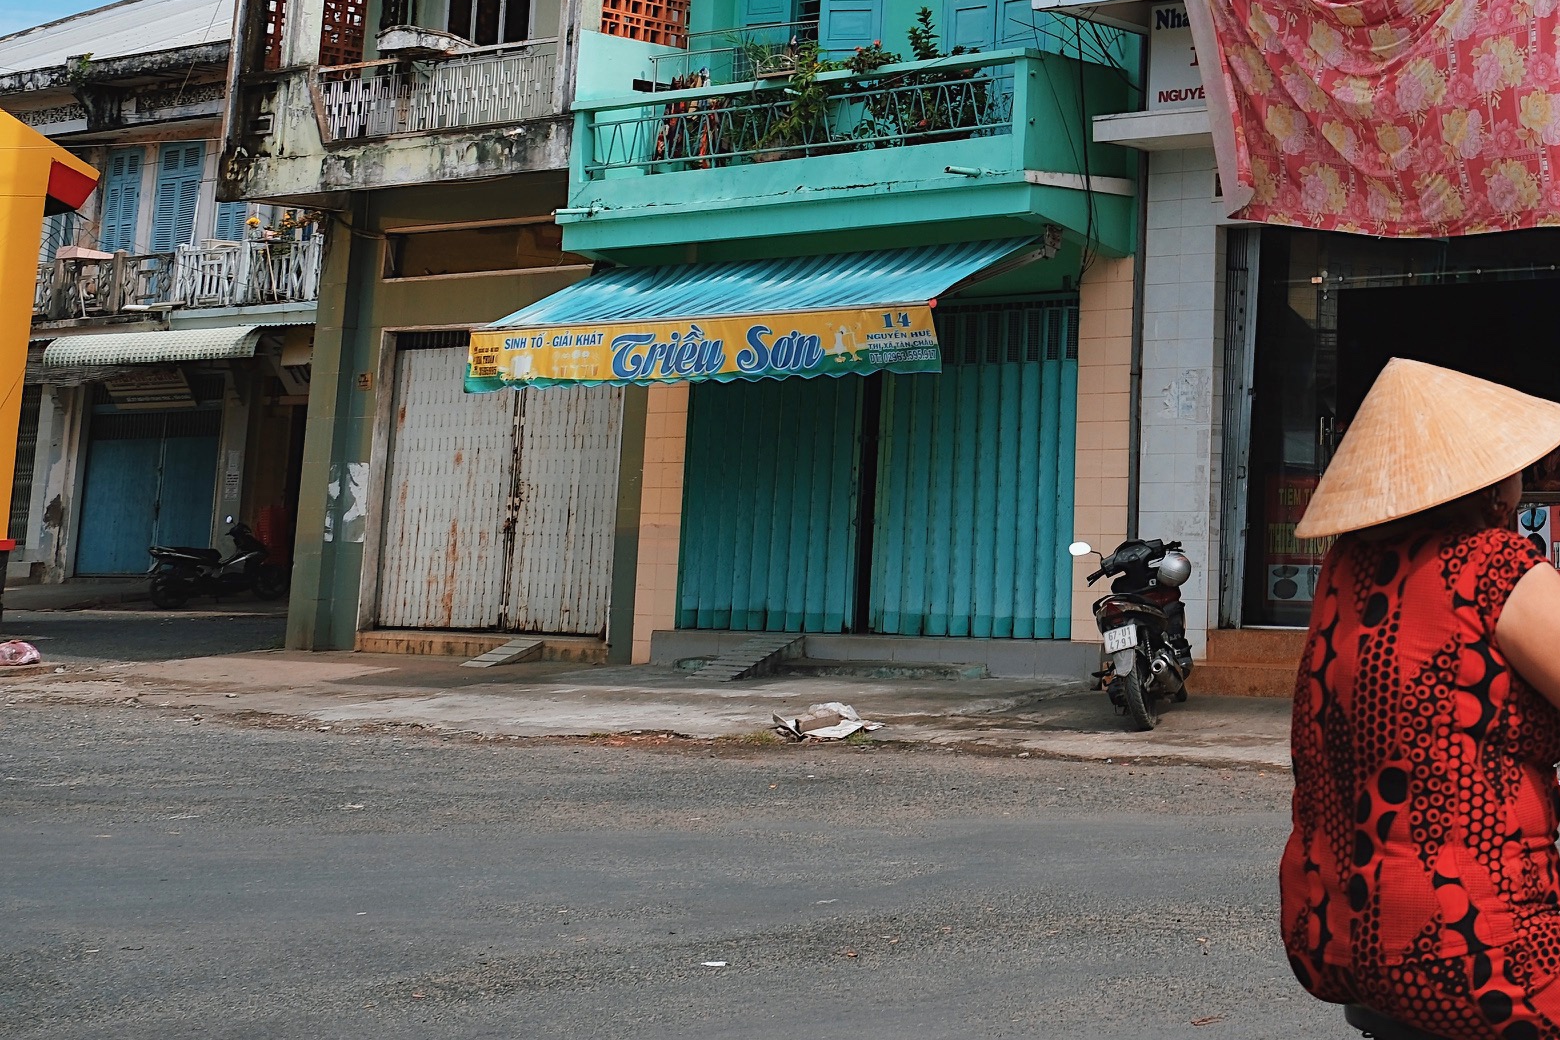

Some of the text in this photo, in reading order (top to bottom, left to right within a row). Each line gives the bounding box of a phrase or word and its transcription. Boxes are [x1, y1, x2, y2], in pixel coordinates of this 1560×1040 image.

[881, 312, 912, 329] 14
[504, 336, 527, 350] SINH
[531, 331, 546, 348] TỐ
[552, 331, 572, 347] GIẢI
[575, 331, 604, 346] KHÁT
[866, 329, 907, 340] NGUYỄN
[610, 324, 825, 379] Triều Sơn
[868, 343, 881, 351] THỊ
